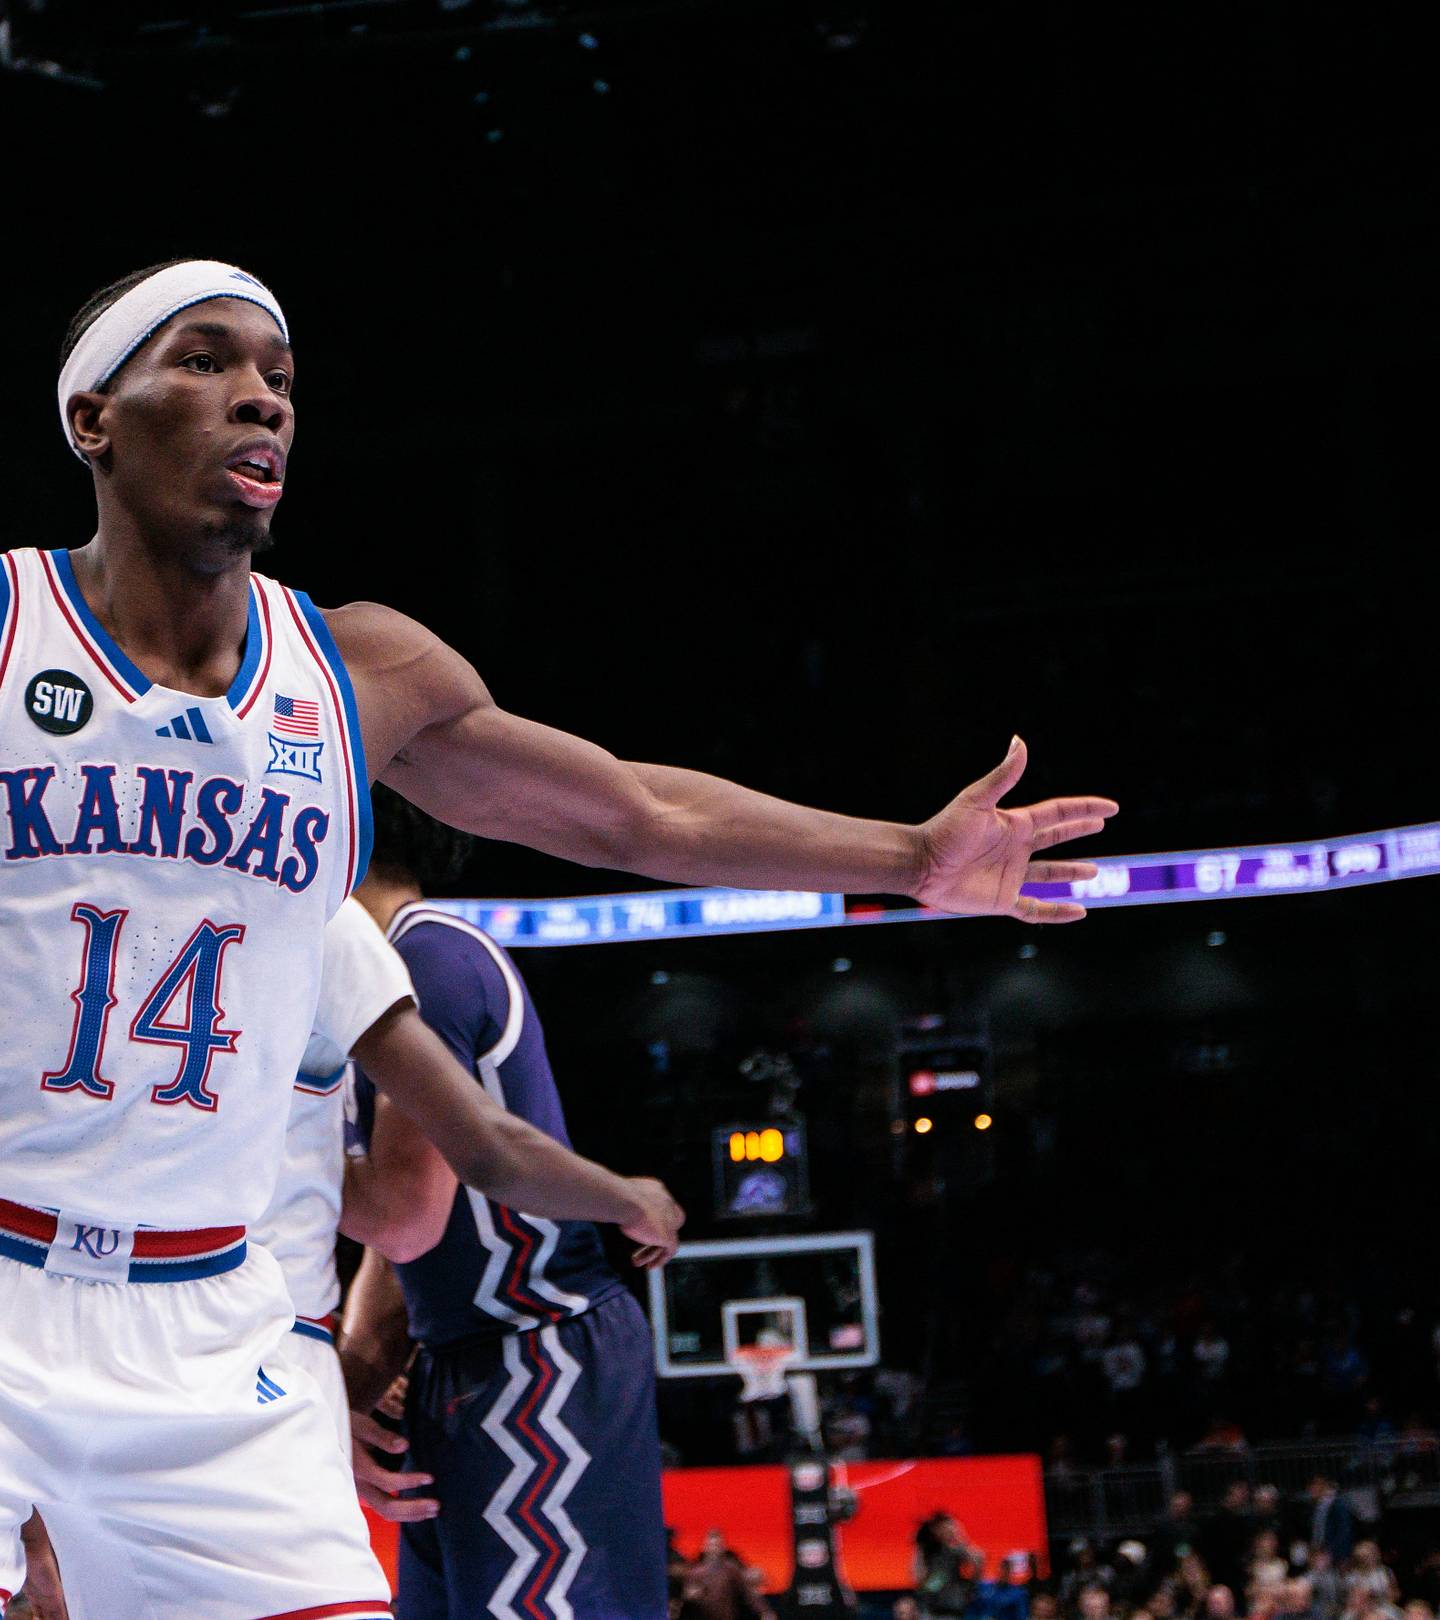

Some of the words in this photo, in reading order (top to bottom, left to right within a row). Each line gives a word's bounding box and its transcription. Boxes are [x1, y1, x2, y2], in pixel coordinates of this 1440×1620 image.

[32, 680, 86, 723] SW
[265, 732, 324, 783] XII
[40, 902, 247, 1112] 14
[70, 1223, 121, 1260] KU
